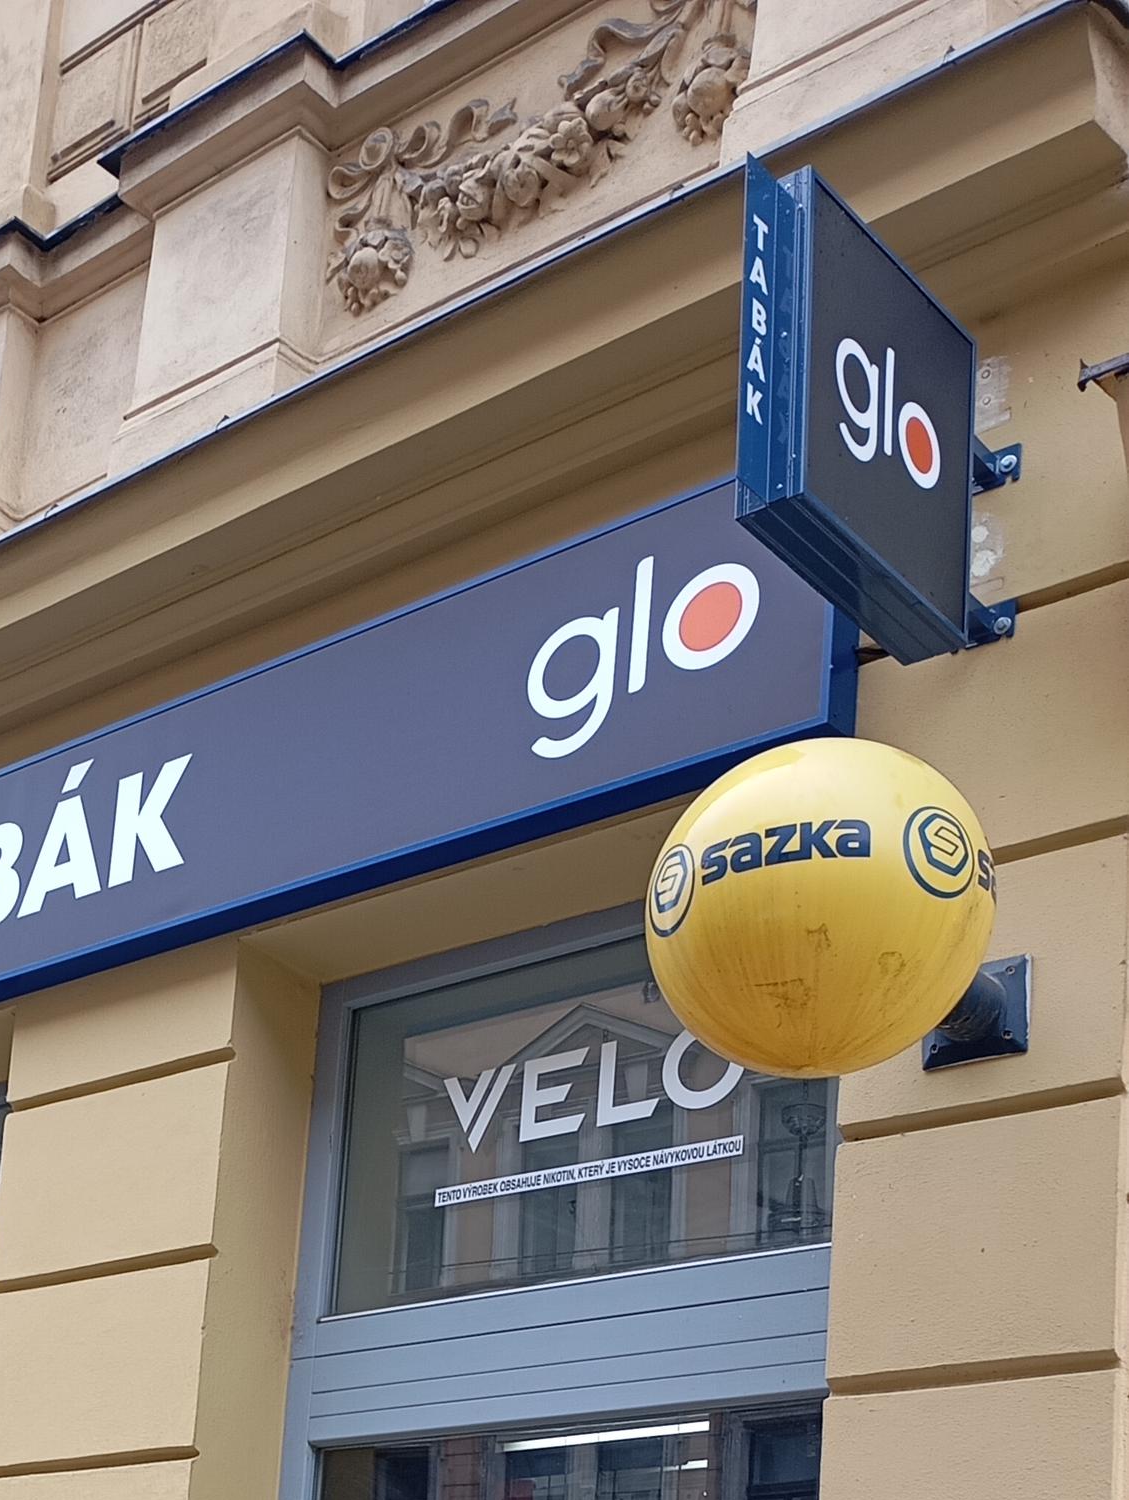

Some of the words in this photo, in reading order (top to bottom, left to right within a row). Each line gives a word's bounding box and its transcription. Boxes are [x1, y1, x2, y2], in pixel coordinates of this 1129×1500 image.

[744, 214, 769, 425] TABÁK
[835, 337, 941, 490] glo
[527, 554, 760, 759] glo
[437, 1189, 462, 1204] TENTO
[462, 1182, 499, 1200] VÝROBEK
[499, 1175, 542, 1192] OBSAHUJE
[542, 1169, 576, 1186] NIKOTIN,
[577, 1162, 606, 1180] KTERÝ
[606, 1162, 617, 1175] JE
[617, 1155, 652, 1173] VYSOCE
[652, 1147, 705, 1167] NÁVYKOVOU
[706, 1138, 742, 1157] LÁTKOU
